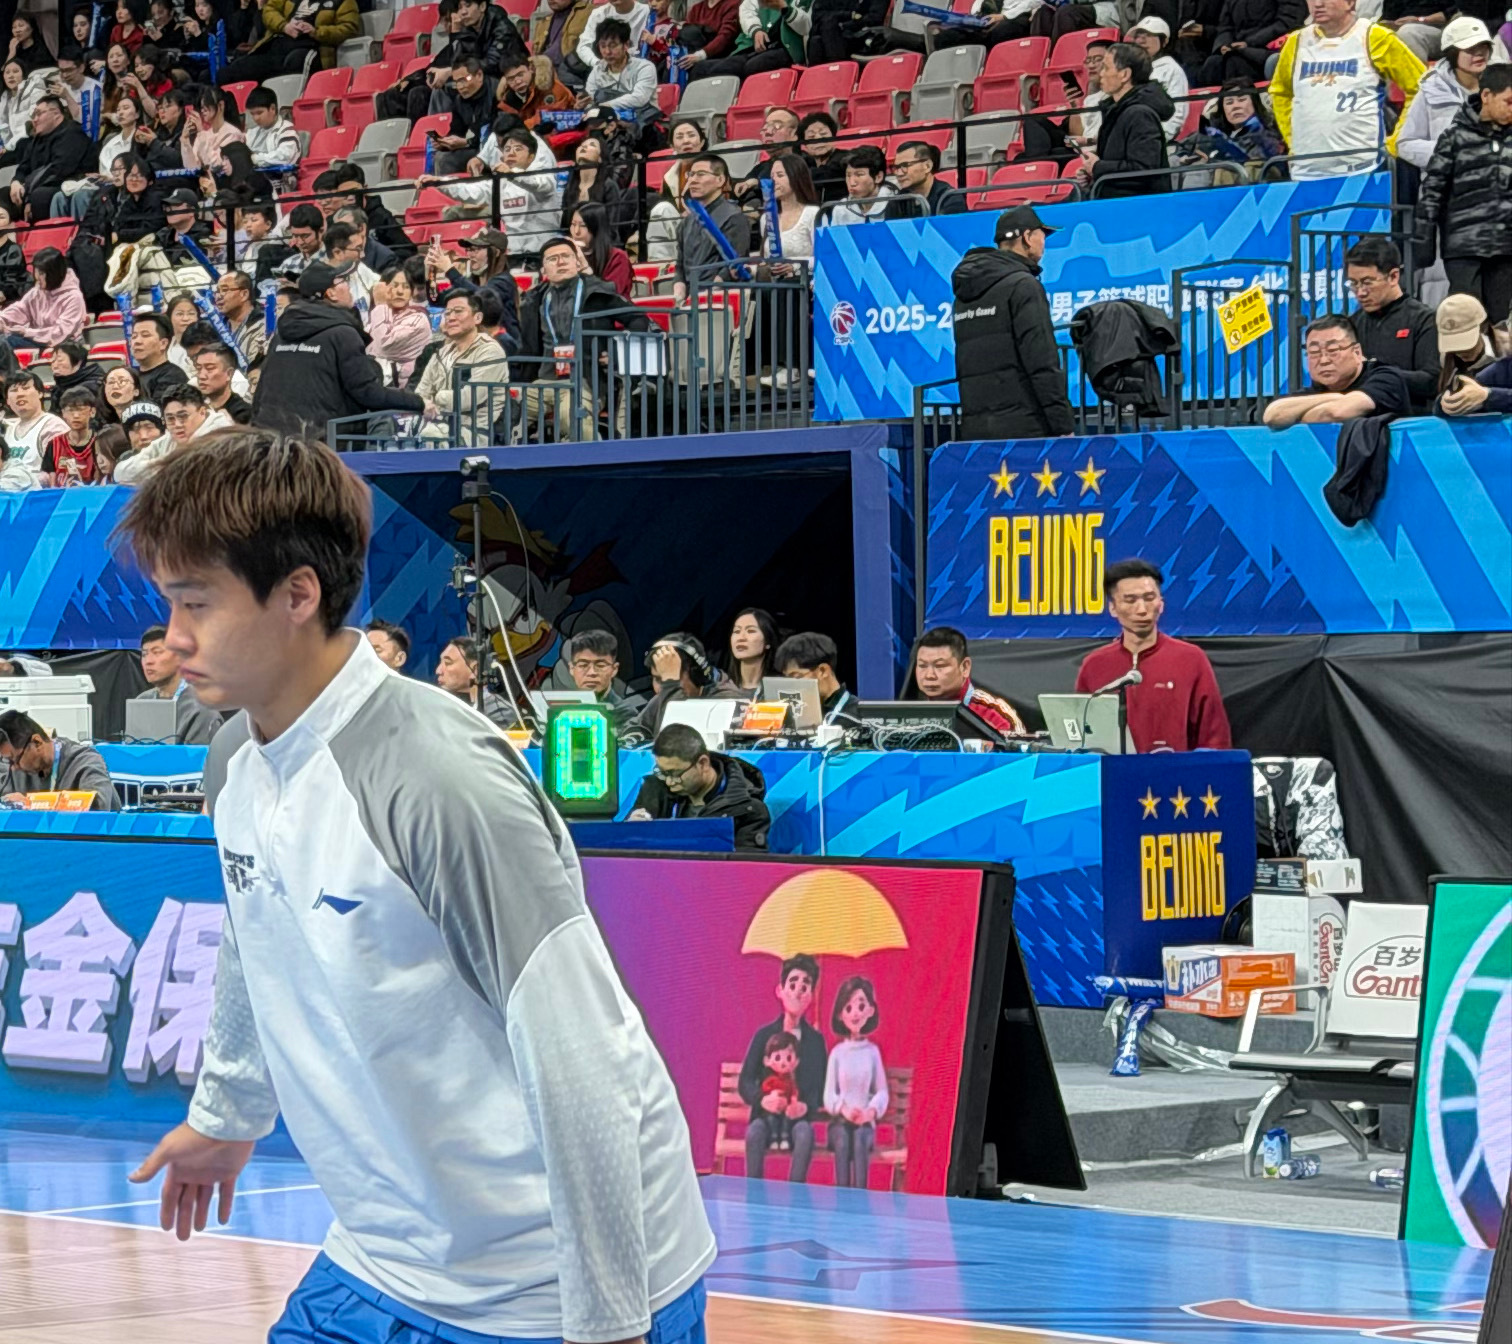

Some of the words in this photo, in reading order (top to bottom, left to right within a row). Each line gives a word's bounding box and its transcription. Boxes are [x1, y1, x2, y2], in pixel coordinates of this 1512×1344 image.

[864, 300, 952, 335] 2025-2
[989, 512, 1105, 617] BEIJING
[554, 709, 608, 799] 0
[1140, 831, 1226, 922] BEIJING
